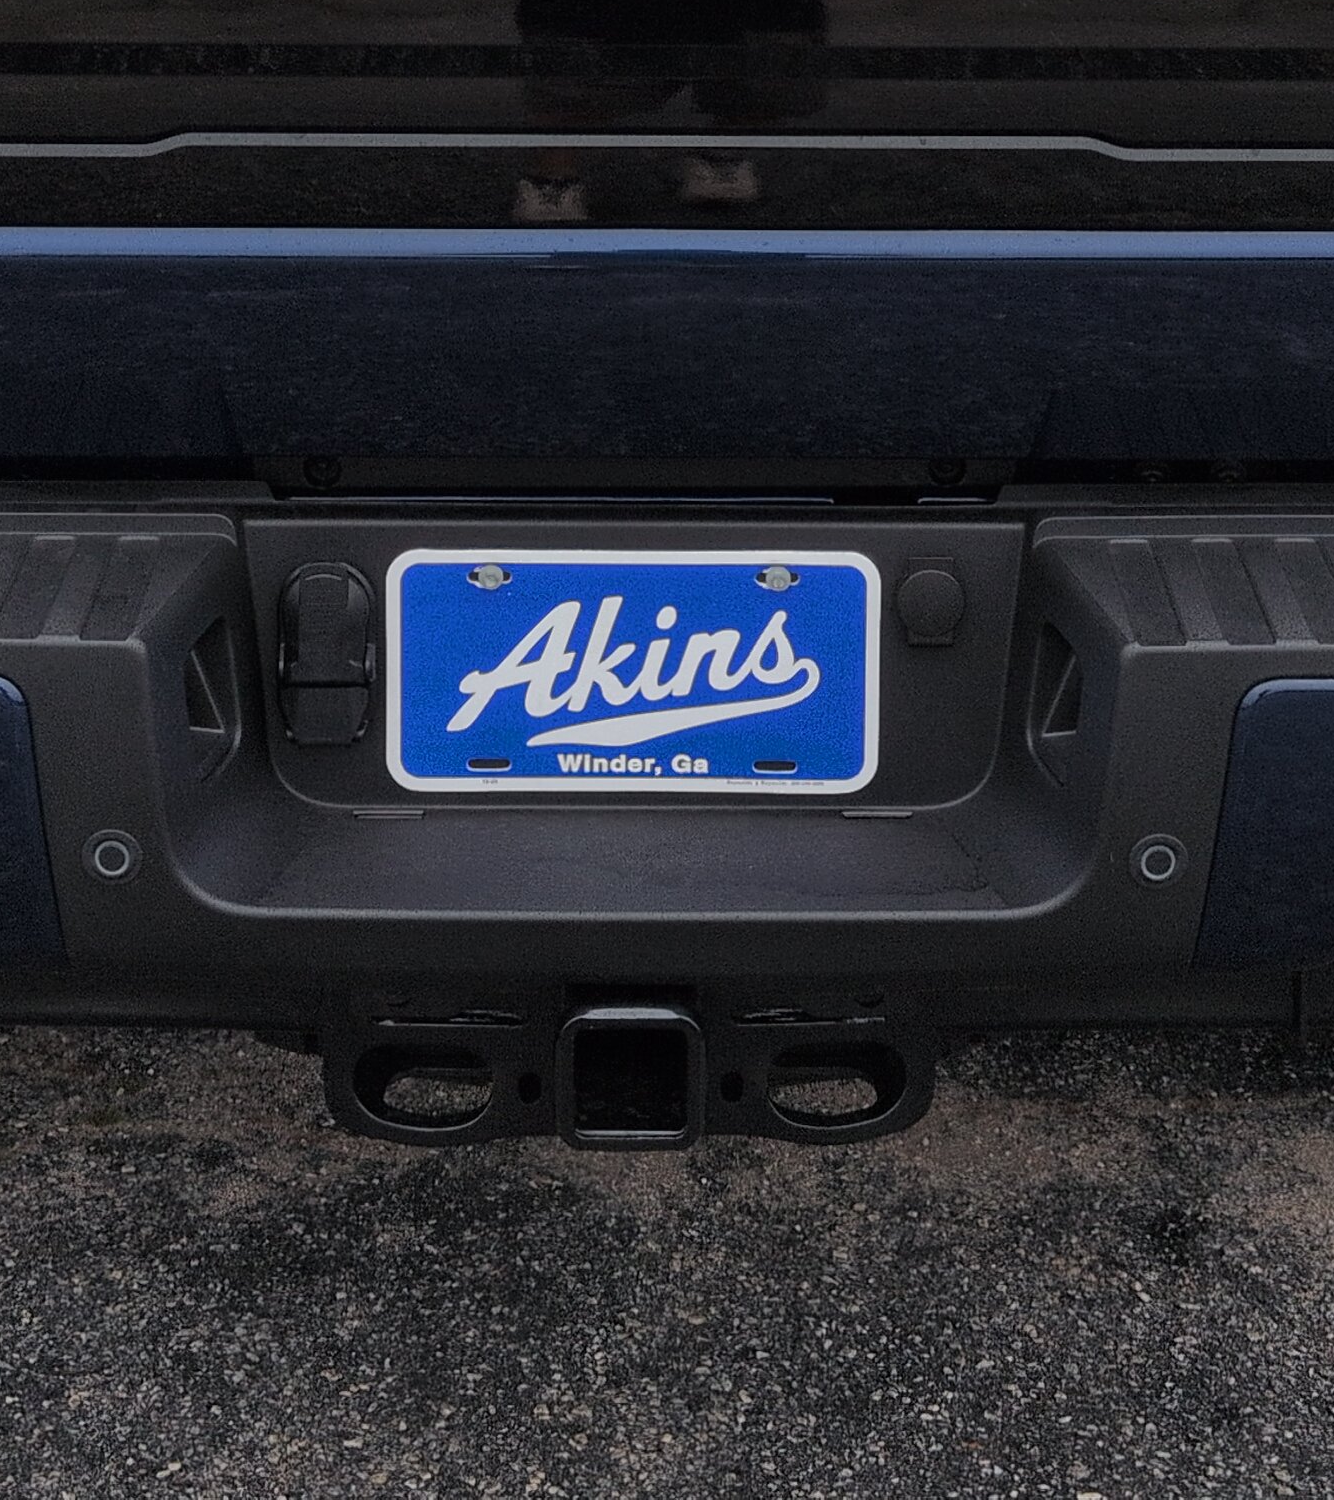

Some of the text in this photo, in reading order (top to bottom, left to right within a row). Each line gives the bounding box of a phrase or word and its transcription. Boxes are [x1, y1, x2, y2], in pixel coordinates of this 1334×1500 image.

[446, 595, 821, 746] Akins
[557, 753, 709, 776] Winder, Ga
